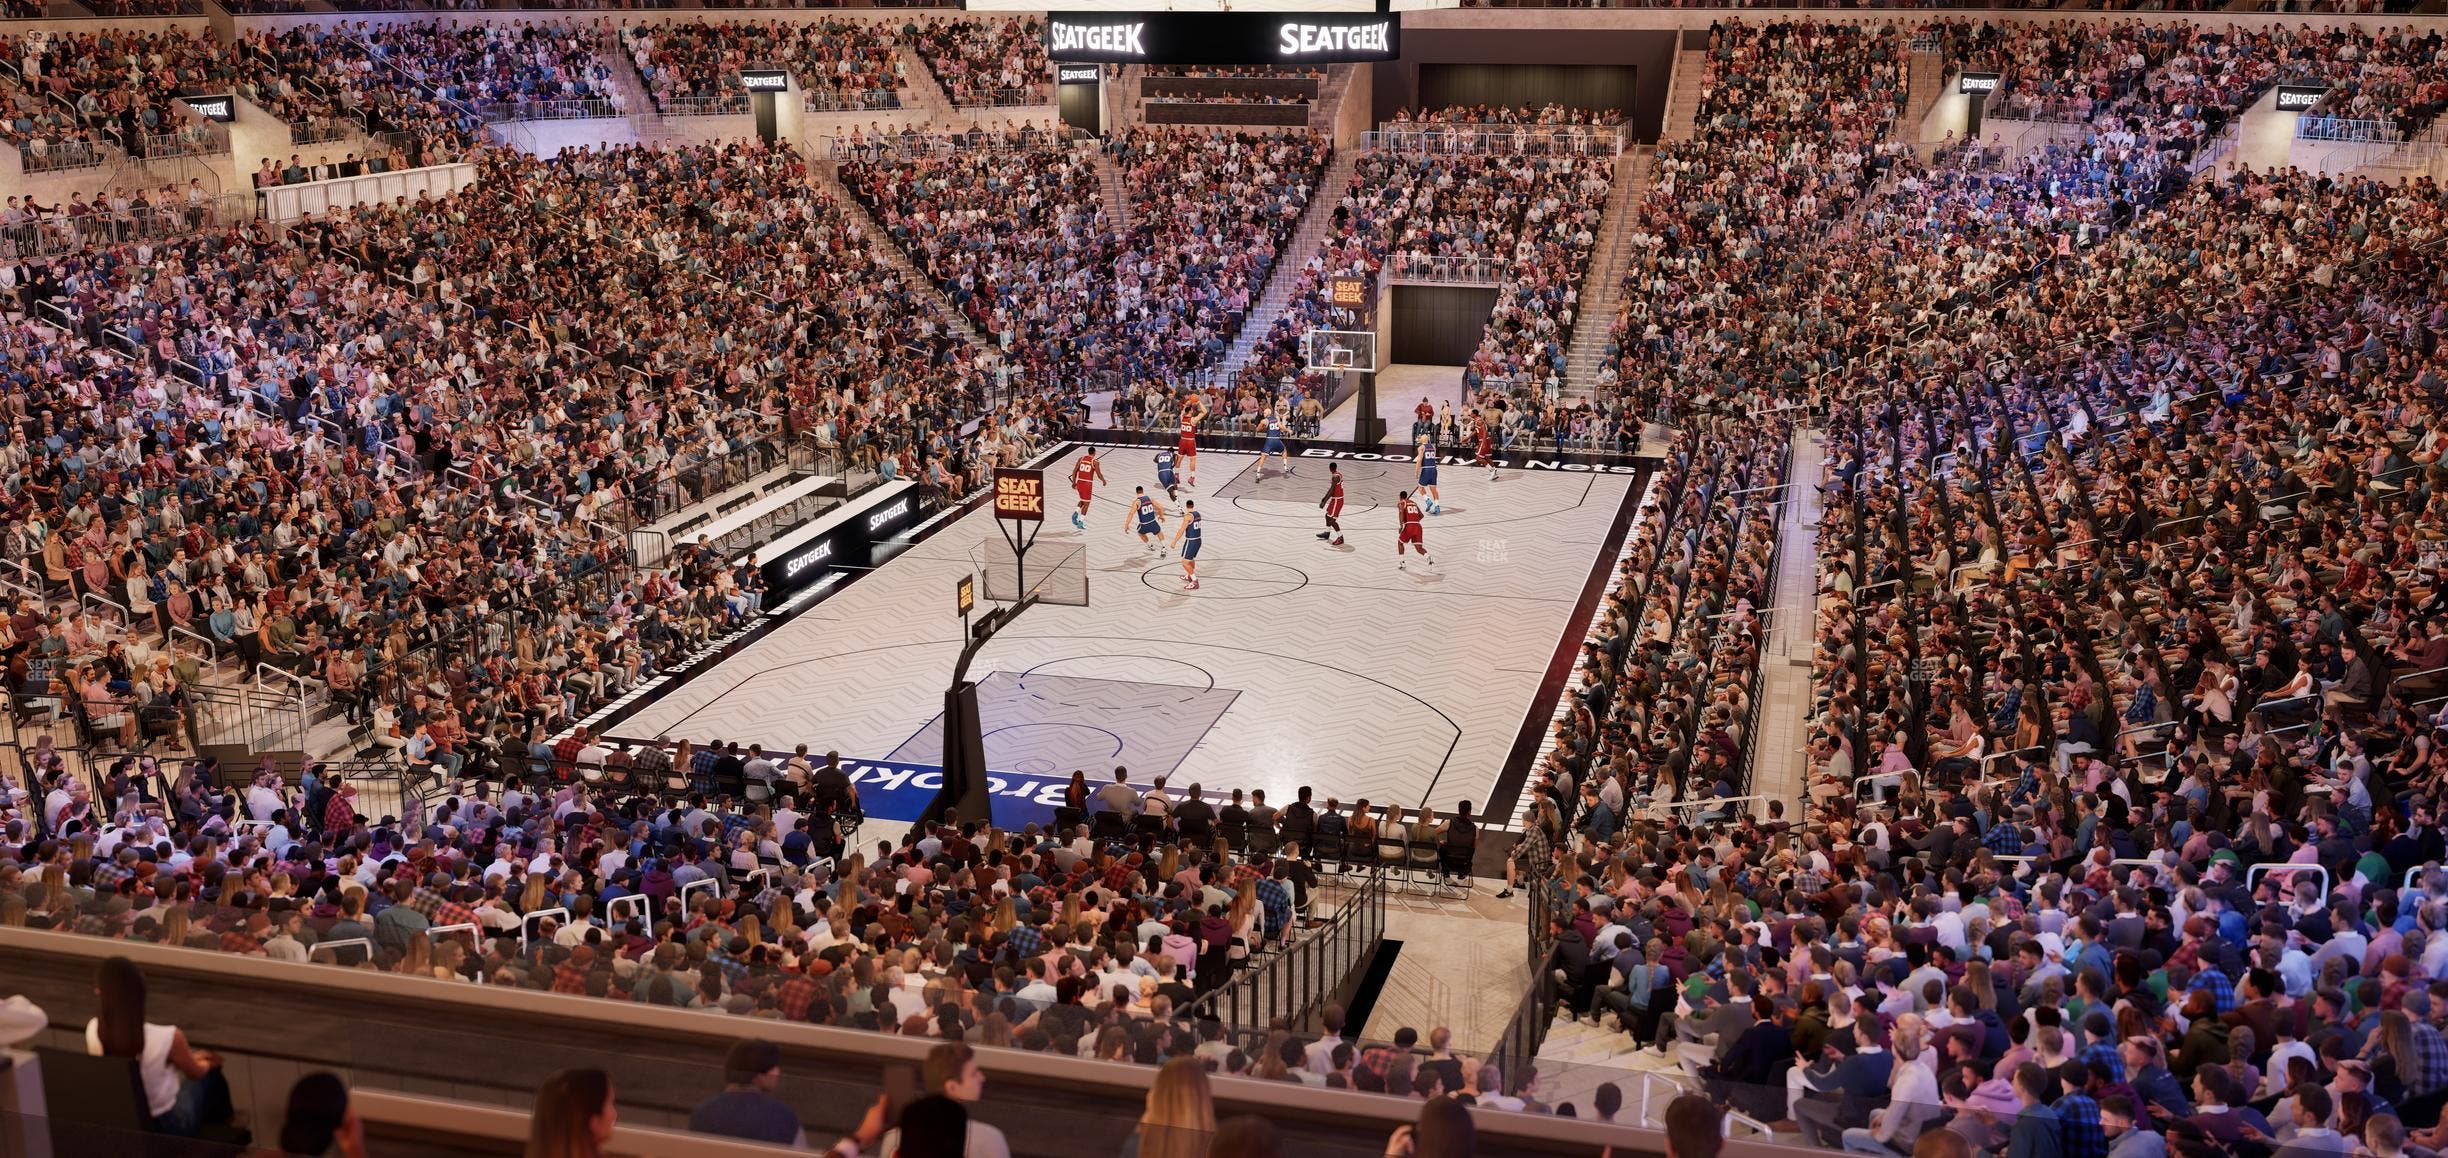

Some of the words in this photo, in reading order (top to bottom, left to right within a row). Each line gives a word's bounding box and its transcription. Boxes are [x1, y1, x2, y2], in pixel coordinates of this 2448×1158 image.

[1052, 21, 1145, 55] SEATGEEK
[1280, 21, 1389, 55] SEATGEEK
[743, 75, 785, 87] SEATGEEK
[1061, 69, 1098, 81] SEATGEEK
[2279, 92, 2322, 105] SEATGEE
[1335, 281, 1362, 292] SEAT
[1334, 292, 1364, 304] GEEK
[1300, 448, 1509, 468] Broolyn
[1525, 460, 1636, 474] Nets
[998, 477, 1040, 495] SEAT
[996, 494, 1042, 513] GEEK
[870, 497, 908, 532] SEATGEEK
[787, 539, 832, 577] SEATGEEK
[960, 582, 972, 597] SEAT
[960, 592, 973, 608] GEEK
